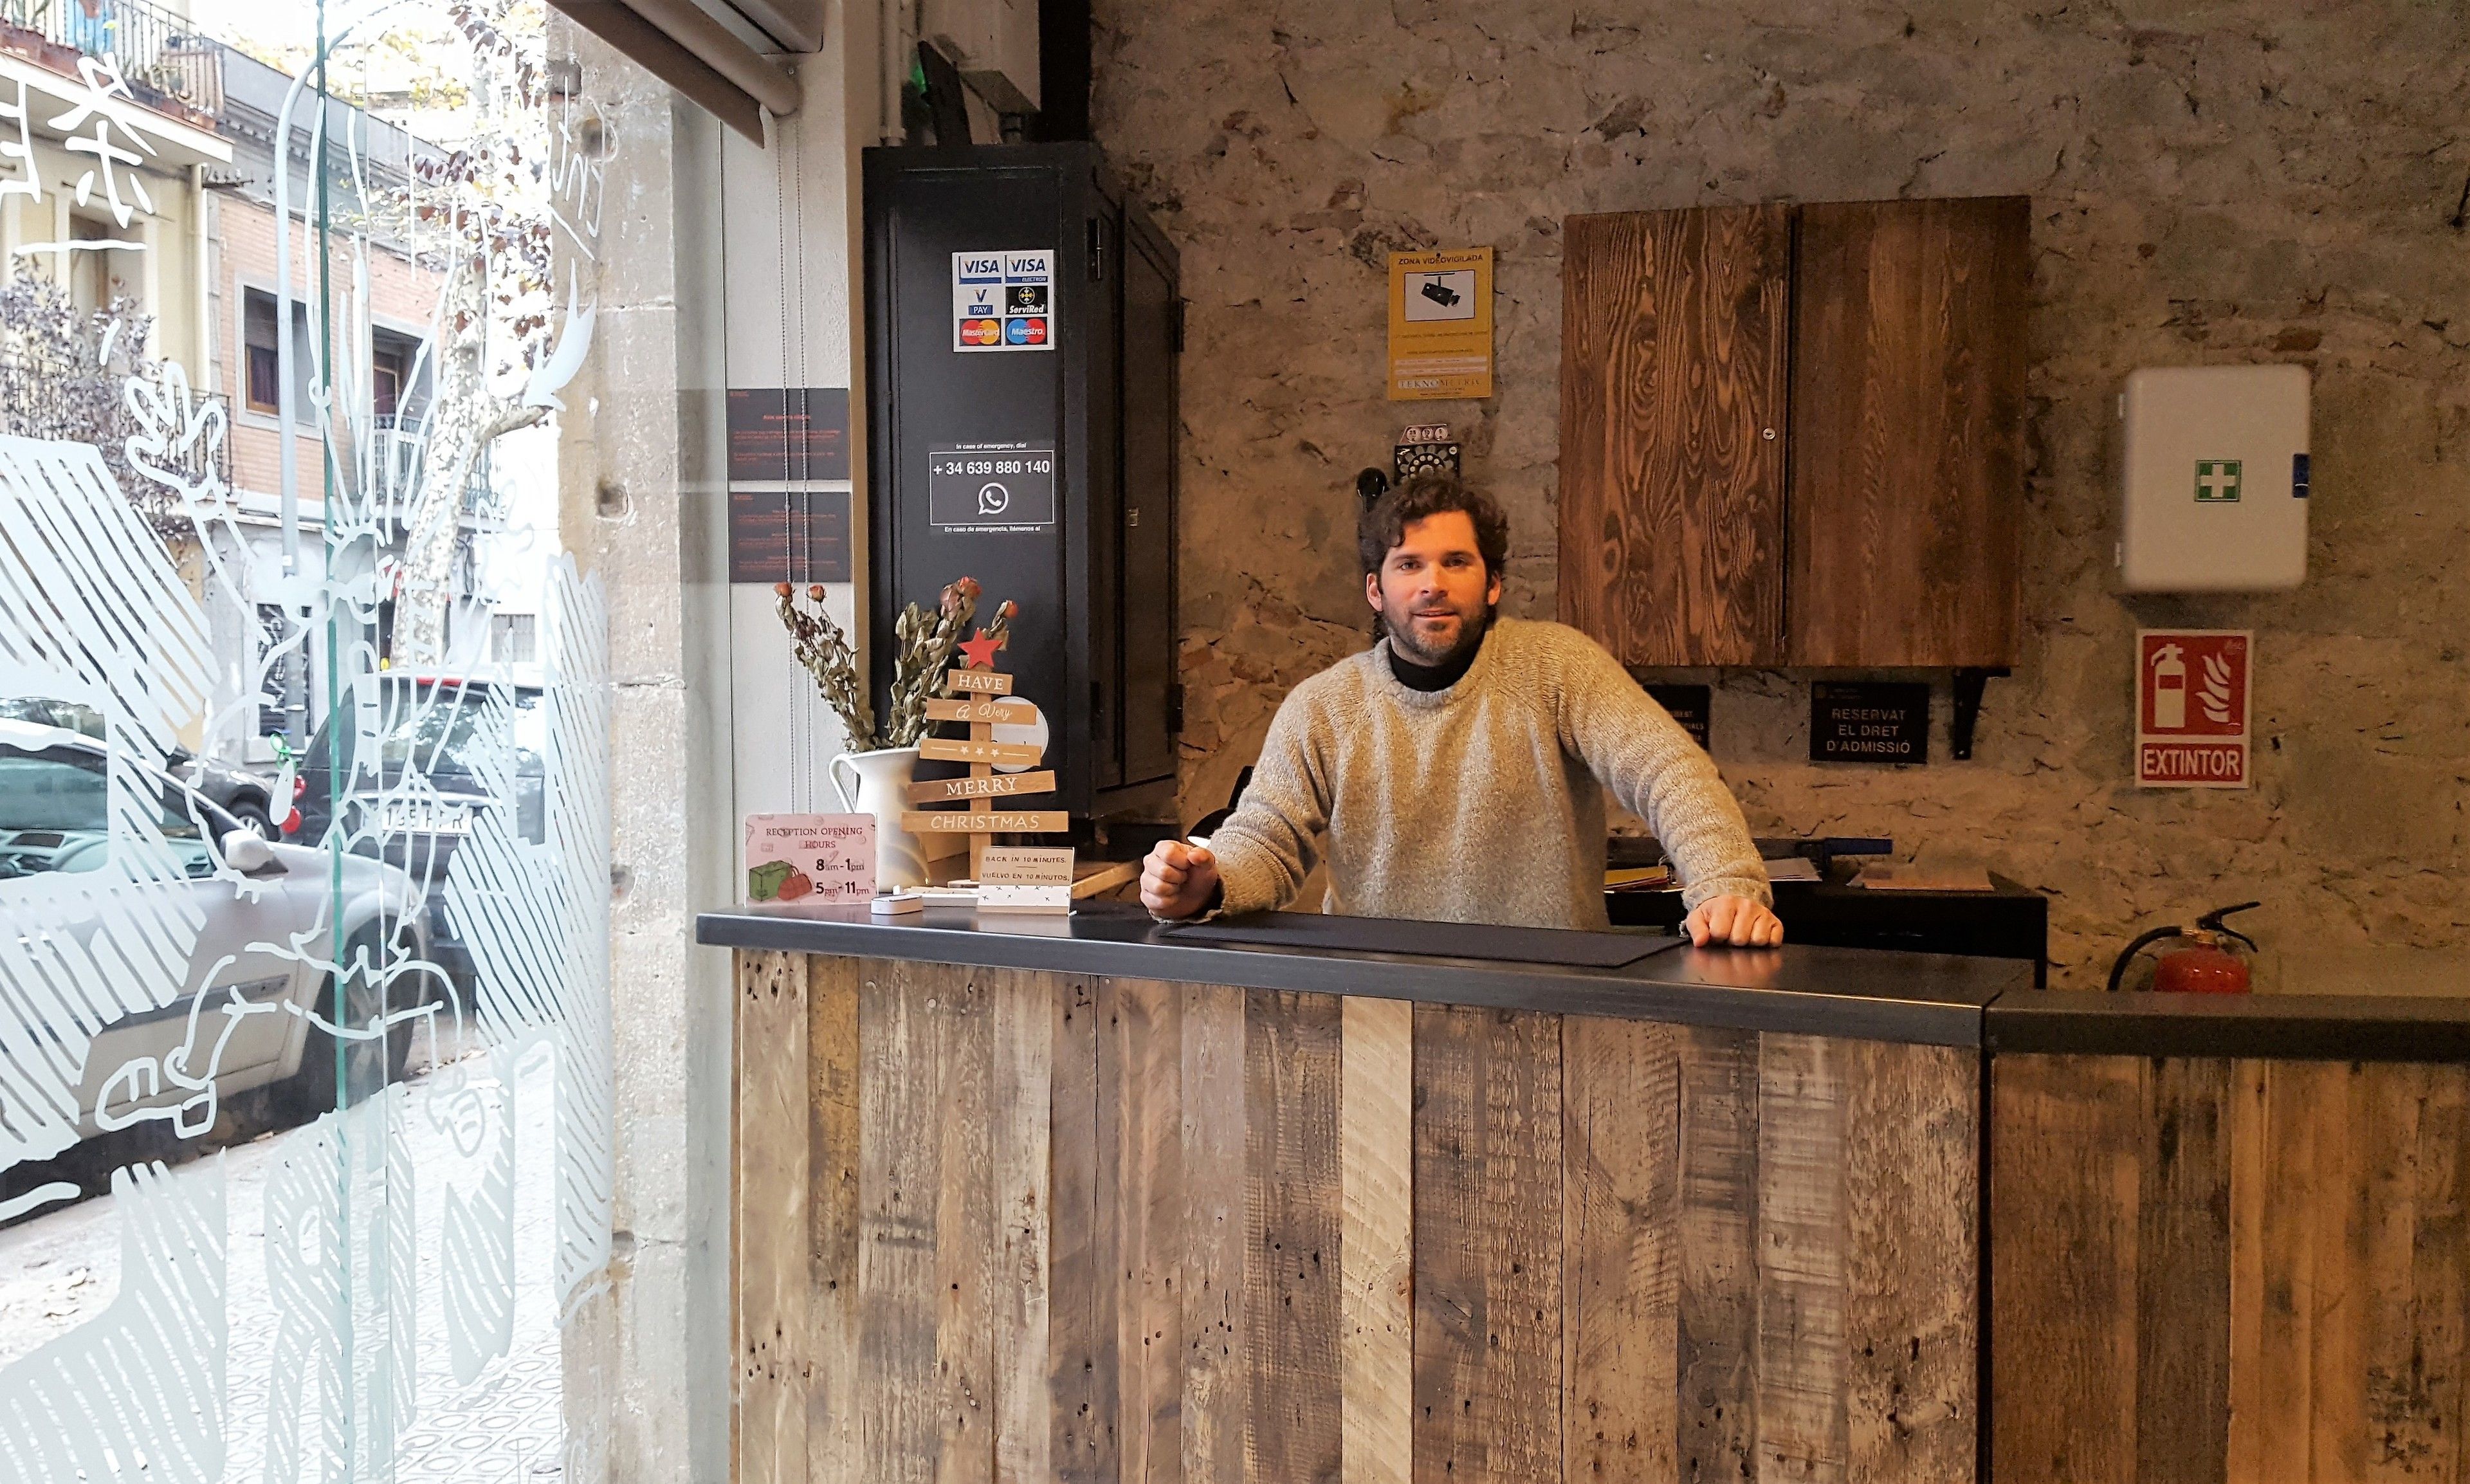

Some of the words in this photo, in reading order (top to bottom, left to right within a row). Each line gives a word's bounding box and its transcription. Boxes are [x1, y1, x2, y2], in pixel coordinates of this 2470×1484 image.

[1009, 259, 1046, 272] VISA
[1422, 254, 1483, 264] VIDEOVIGILADA
[964, 260, 1000, 273] VISA
[974, 289, 987, 303] V
[973, 306, 989, 315] PAY
[1009, 305, 1044, 314] ServiRed
[1011, 328, 1043, 336] Maestro
[946, 462, 963, 475] 34
[966, 461, 992, 475] 639
[996, 461, 1021, 473] 880
[1025, 460, 1050, 473] 140
[957, 673, 1004, 691] HAVE
[956, 704, 969, 719] A
[978, 703, 1012, 721] Very
[1832, 708, 1906, 720] RESERVAT
[1838, 724, 1856, 736] EL
[1861, 725, 1899, 737] DRET
[1827, 740, 1910, 754] D'ADMISSIÓ
[2143, 749, 2240, 776] EXTINTOR
[946, 777, 1018, 796] MERRY
[931, 815, 1039, 830] CHRISTMAS
[766, 827, 817, 836] RECEPTION
[821, 827, 863, 836] OPENING
[805, 840, 836, 848] HOURS
